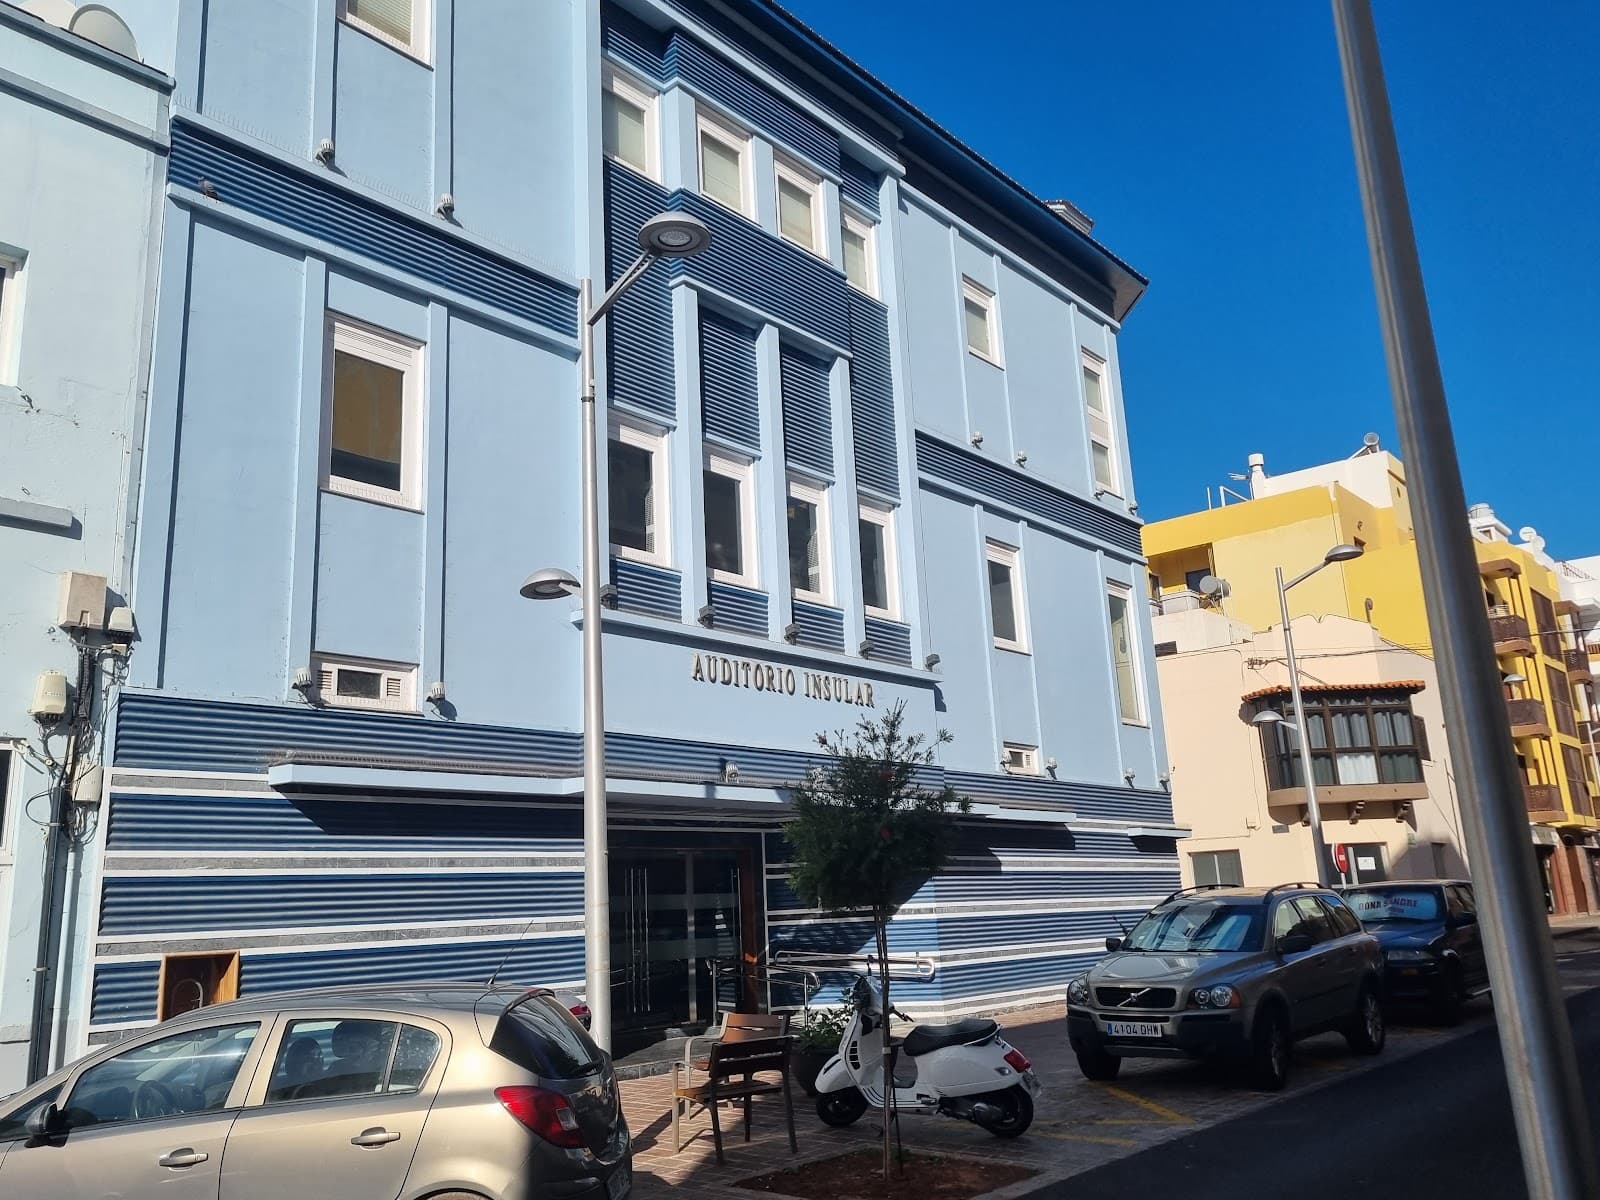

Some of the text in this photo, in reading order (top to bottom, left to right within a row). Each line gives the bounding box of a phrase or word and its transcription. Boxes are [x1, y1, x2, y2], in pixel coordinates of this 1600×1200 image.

[692, 653, 875, 709] AUDITORIO INSULAR
[1114, 1024, 1138, 1035] 4104
